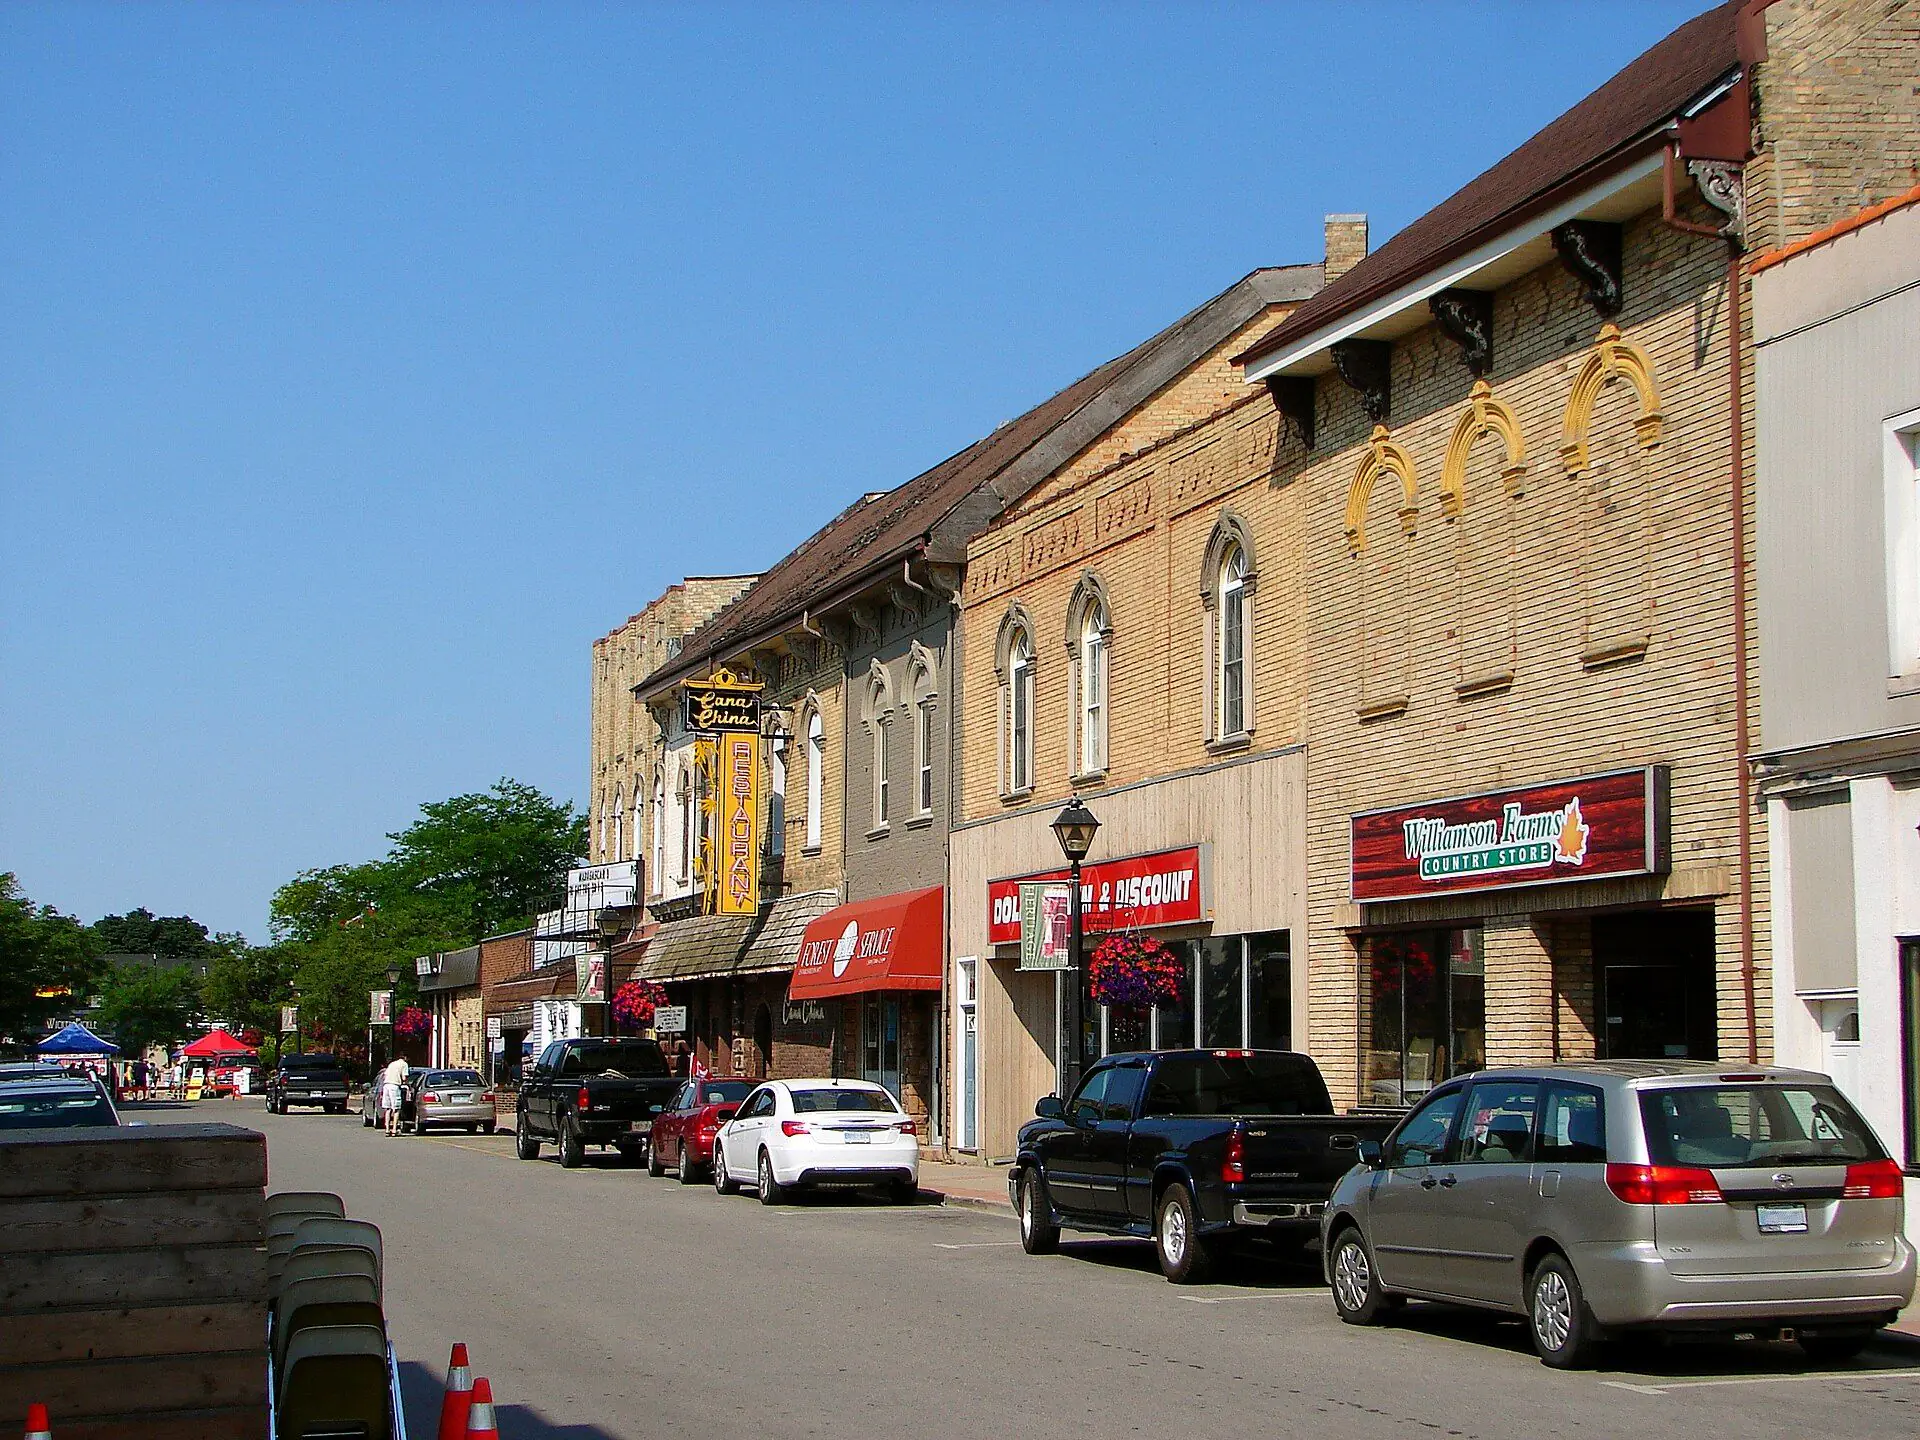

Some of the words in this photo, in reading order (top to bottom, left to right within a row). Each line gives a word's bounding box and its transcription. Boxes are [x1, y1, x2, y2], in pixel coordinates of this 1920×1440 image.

[694, 709, 756, 728] China
[731, 742, 750, 908] RESTAURANT
[1403, 818, 1496, 858] Williamson
[1502, 804, 1563, 843] Farms
[1423, 851, 1490, 875] COUNTRY
[1499, 843, 1549, 864] STORE
[1099, 881, 1111, 912] &
[1115, 869, 1193, 909] DISCOUNT
[1025, 884, 1036, 960] HERITAGE
[801, 939, 835, 967] FOREST
[857, 927, 896, 959] SERVICE
